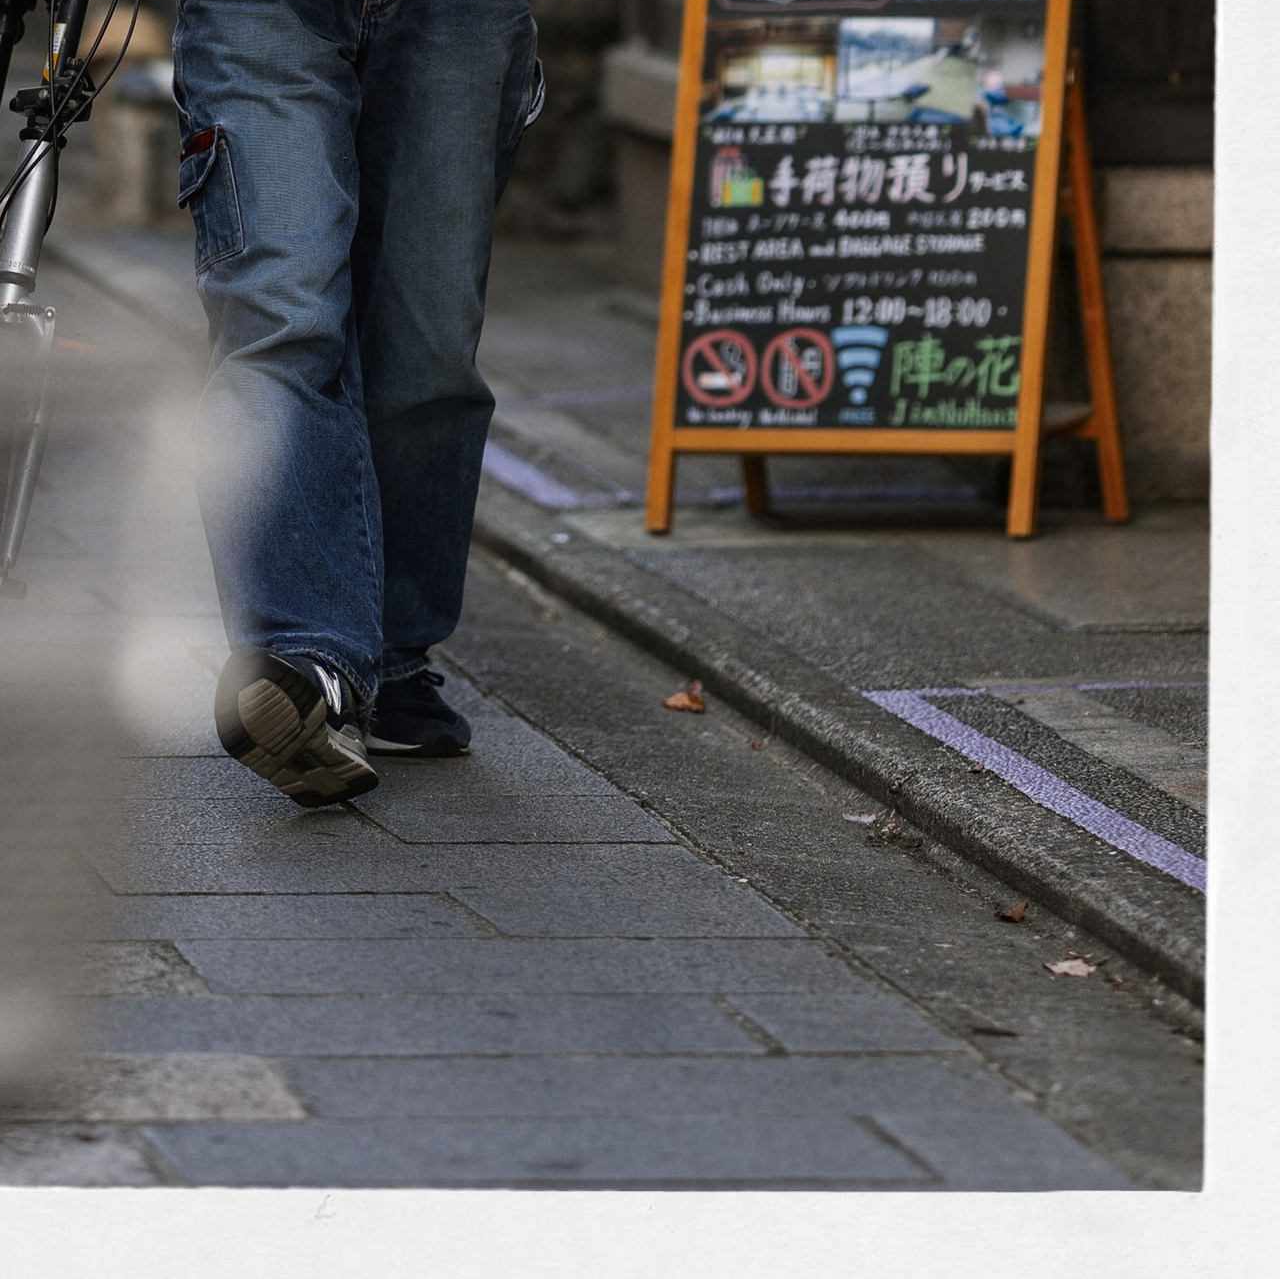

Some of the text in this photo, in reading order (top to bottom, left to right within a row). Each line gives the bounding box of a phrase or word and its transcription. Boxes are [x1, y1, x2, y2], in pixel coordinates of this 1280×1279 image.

[698, 240, 750, 265] REST
[751, 237, 805, 260] AREA
[696, 271, 750, 298] Cash
[692, 296, 775, 327] Business
[775, 295, 832, 324] Hours
[889, 331, 1020, 399] 陣の花
